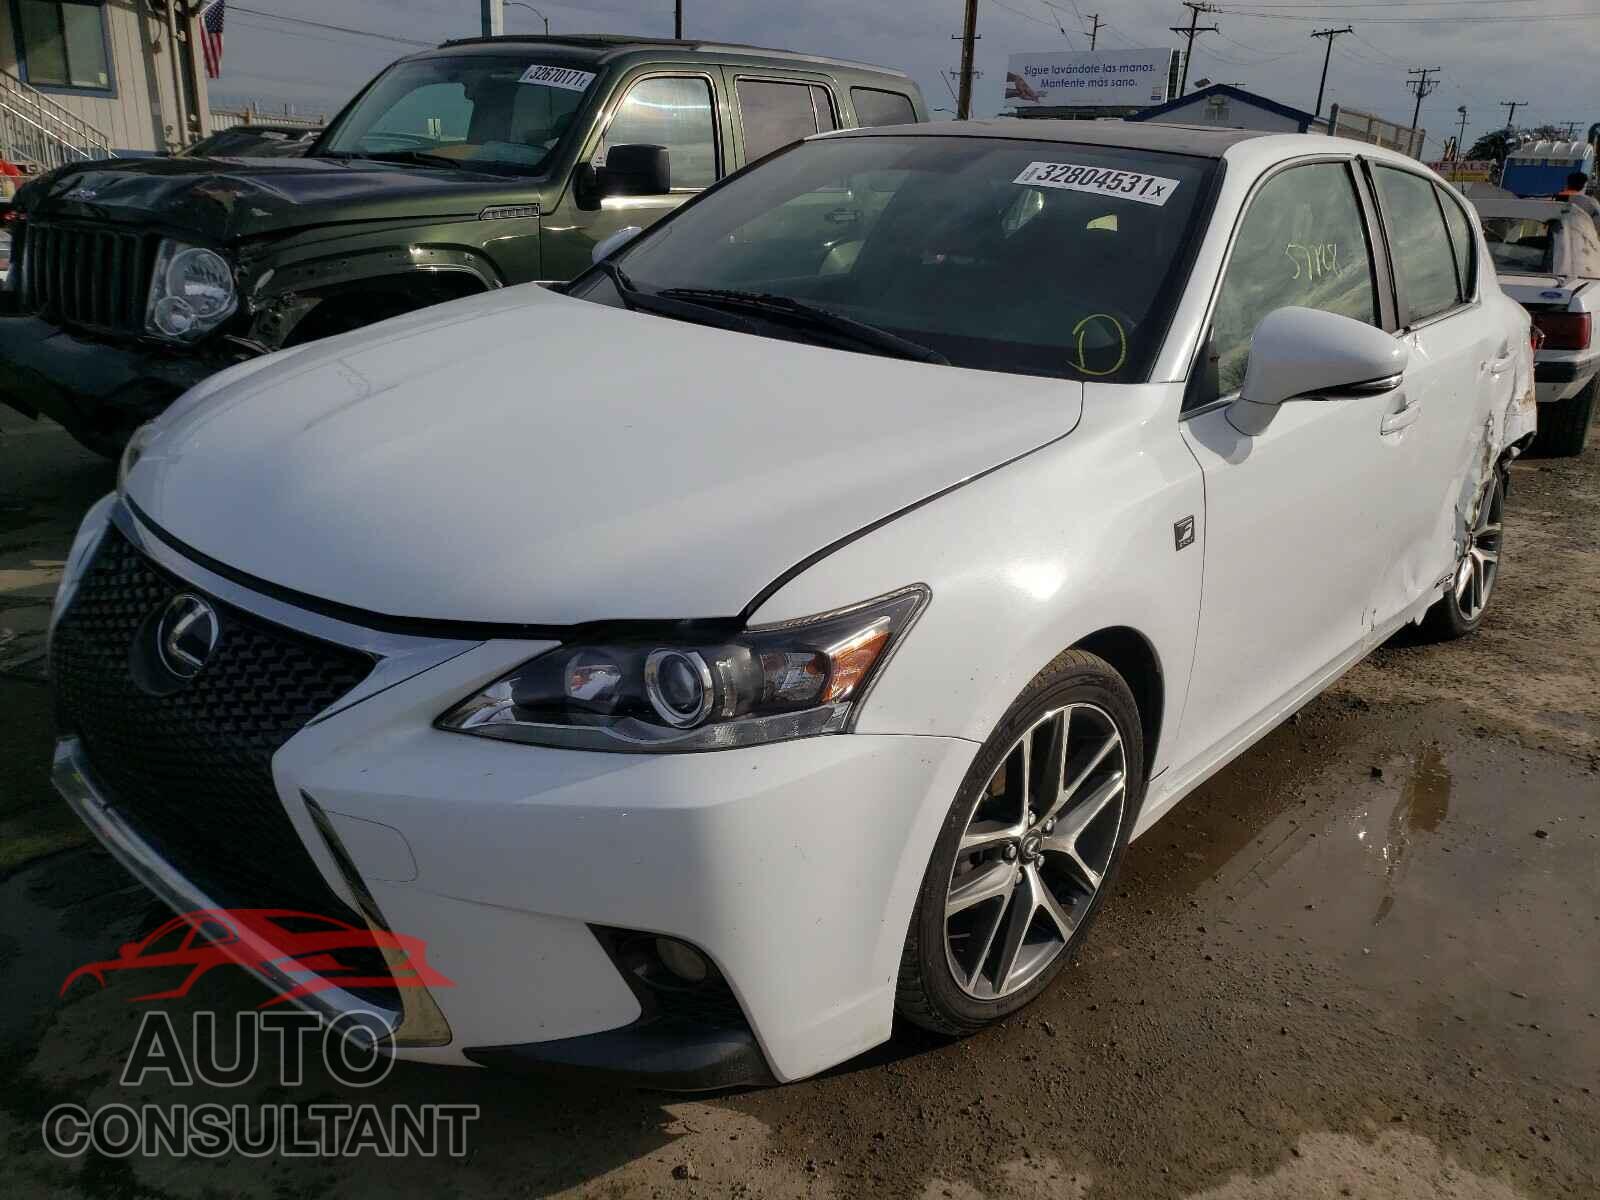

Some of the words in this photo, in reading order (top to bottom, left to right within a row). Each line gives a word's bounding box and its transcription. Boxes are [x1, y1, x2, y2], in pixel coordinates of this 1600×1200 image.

[1024, 64, 1049, 77] Sigue
[1103, 64, 1119, 73] las
[1041, 79, 1086, 89] Mantente
